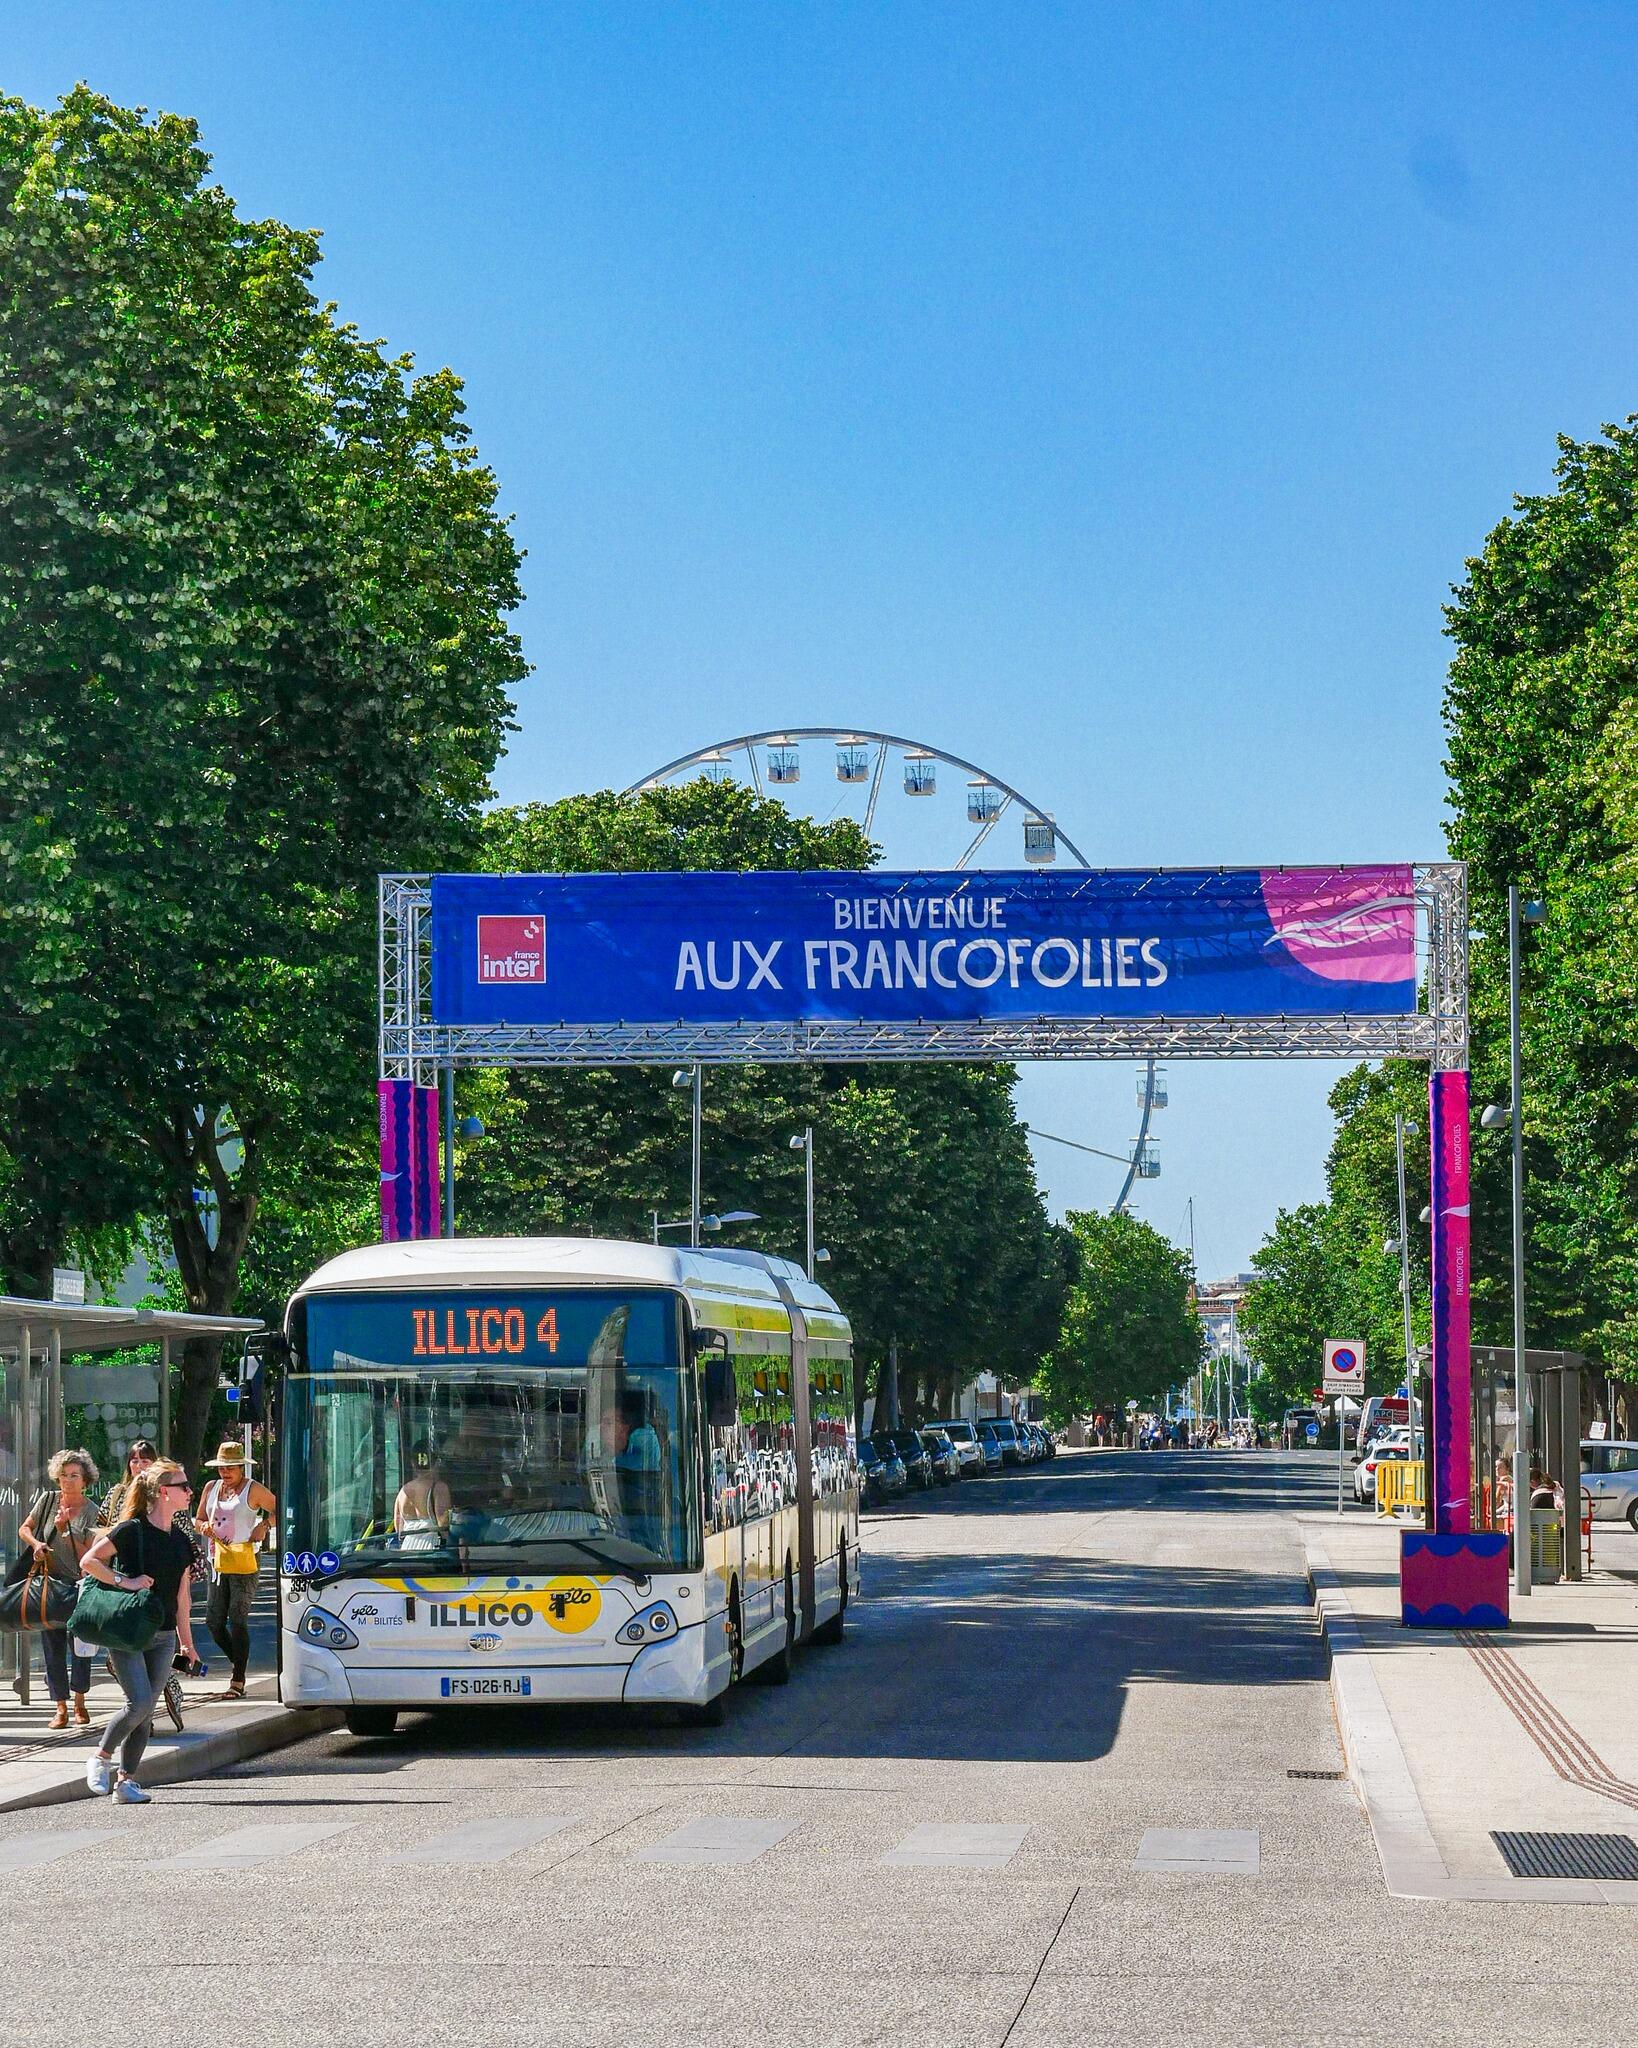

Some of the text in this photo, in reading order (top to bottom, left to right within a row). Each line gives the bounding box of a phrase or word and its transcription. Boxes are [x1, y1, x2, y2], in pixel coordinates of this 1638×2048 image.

[833, 897, 1008, 930] BIENVENUE
[483, 954, 540, 978] inter
[514, 950, 540, 959] france
[674, 937, 1168, 992] AUX FRANCOFOLIES
[380, 1093, 388, 1142] FRANCOFOLIES
[1453, 1124, 1462, 1174] FRANCOFOLIES
[1455, 1246, 1464, 1296] FRANCOFOLIES
[412, 1307, 560, 1355] ILLICO 4
[290, 1578, 307, 1593] 393
[350, 1604, 379, 1621] yélo
[430, 1602, 534, 1627] ILLICO
